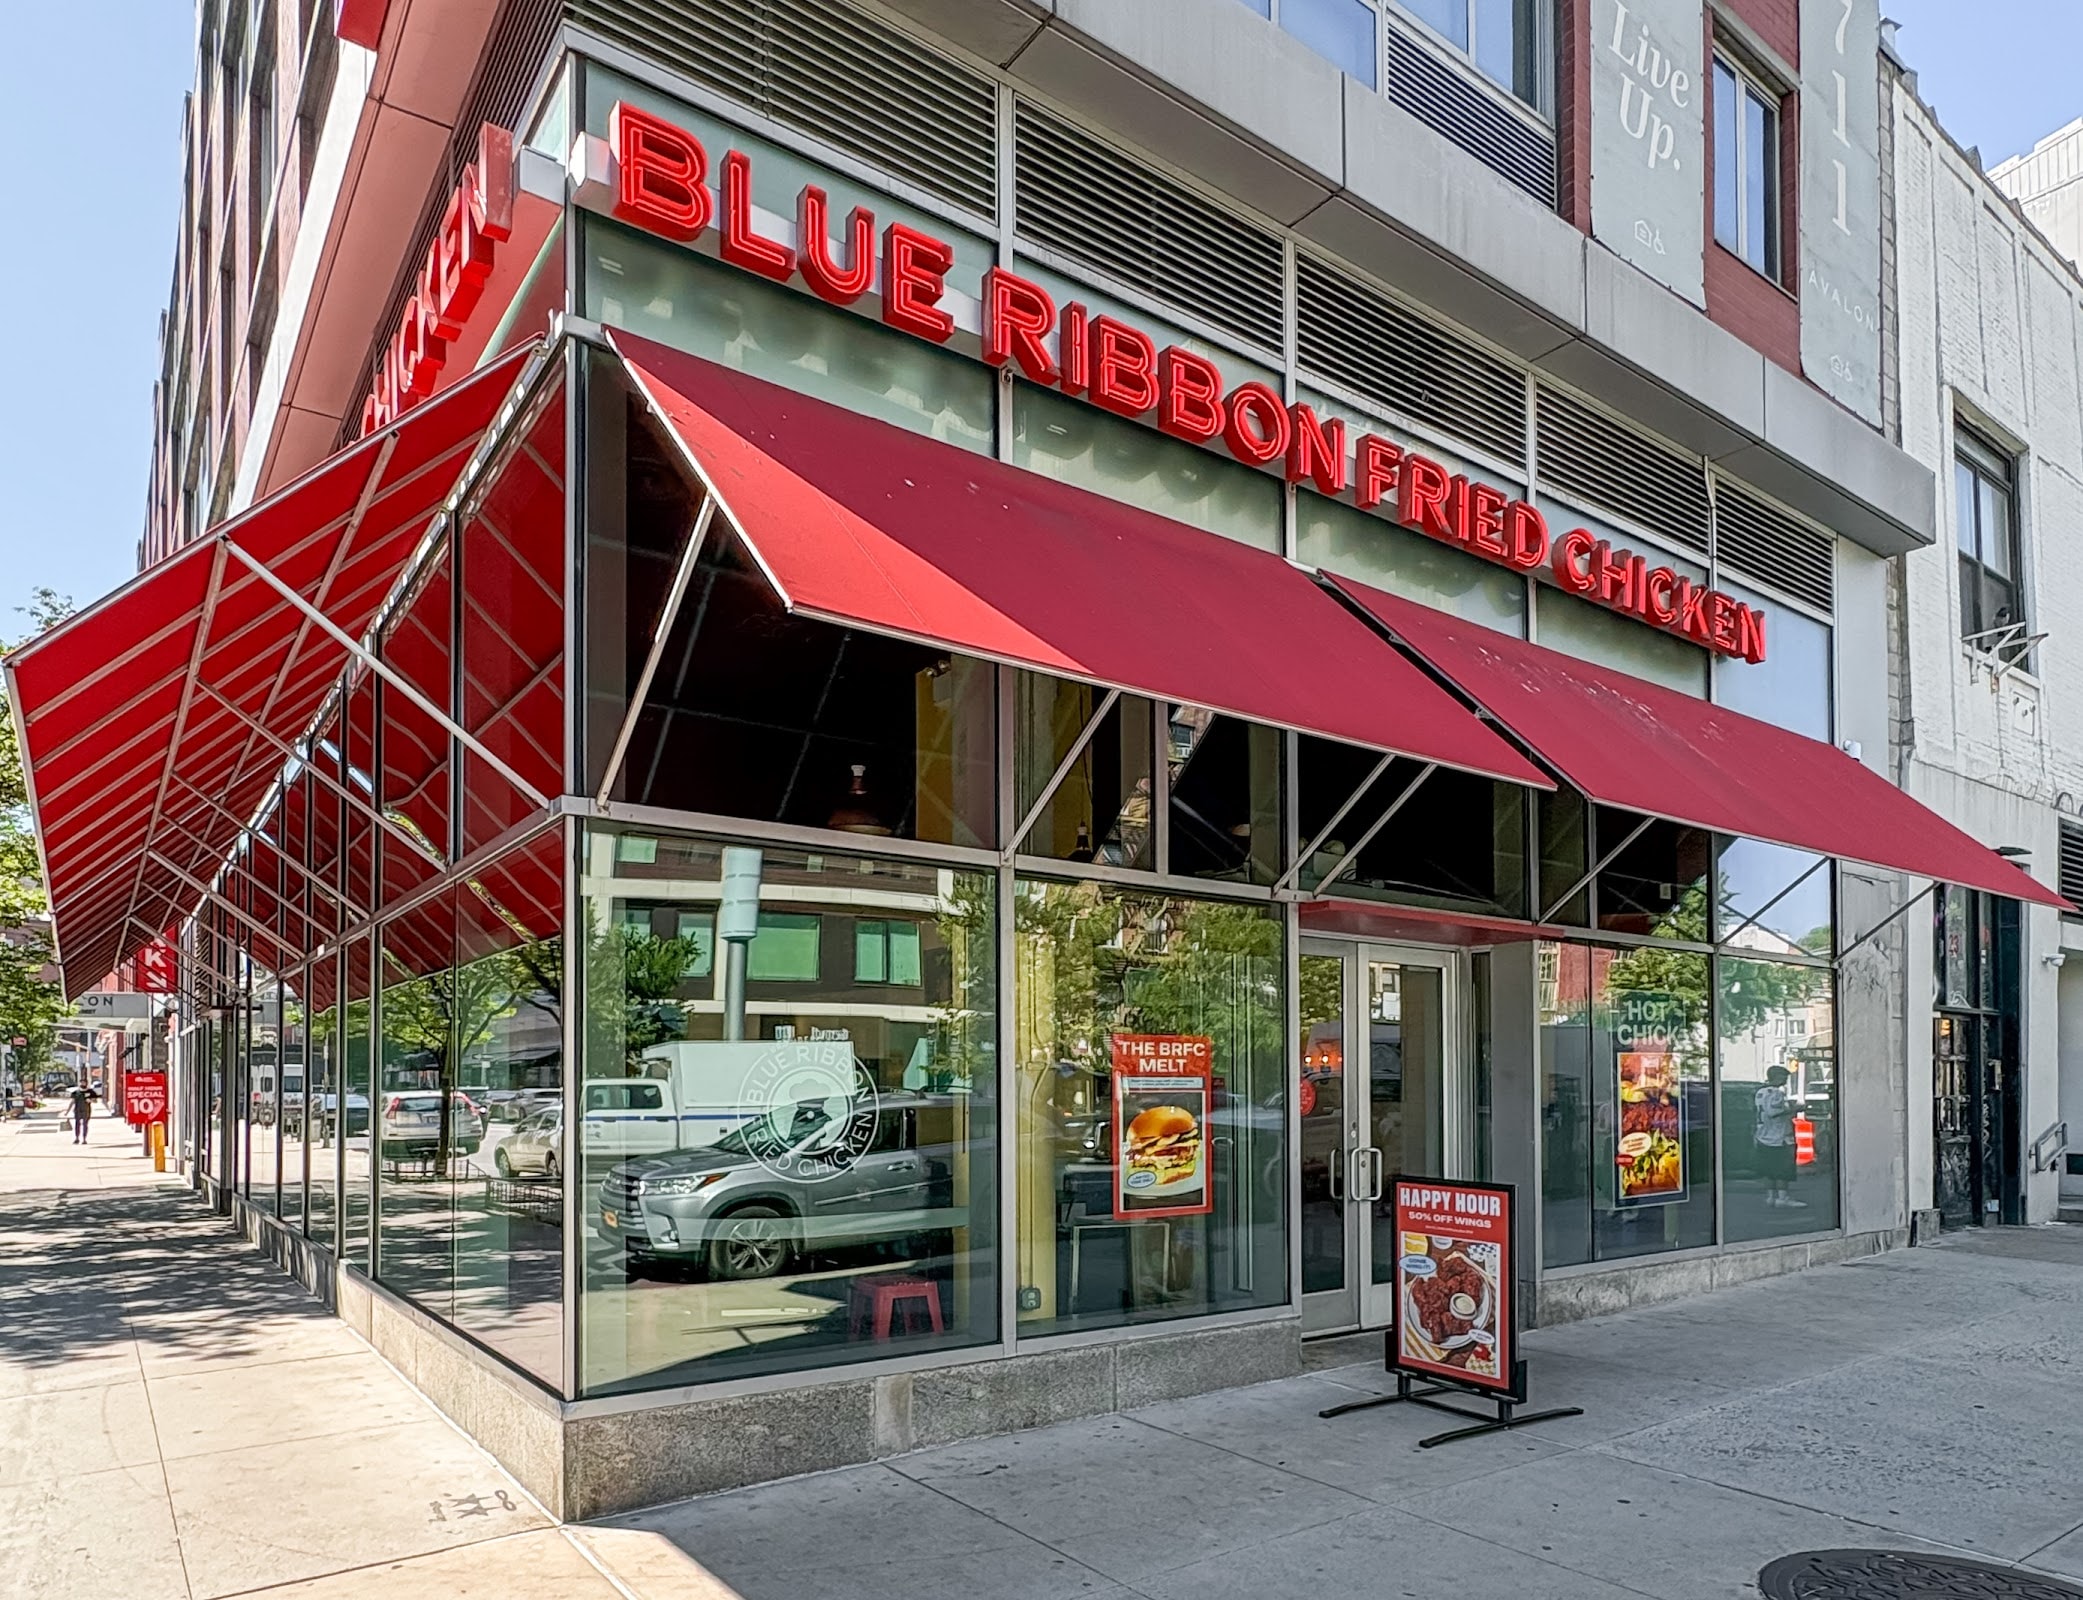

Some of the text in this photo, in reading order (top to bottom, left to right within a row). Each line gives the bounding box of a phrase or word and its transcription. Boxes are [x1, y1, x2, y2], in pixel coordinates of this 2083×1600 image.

[1608, 0, 1690, 108] Live
[1619, 72, 1681, 171] Up.
[1808, 270, 1875, 332] AVALON
[608, 100, 1767, 664] BLUE RIBBON FRIED CHICKEN
[1627, 1000, 1668, 1021] HOT
[746, 1046, 872, 1105] BLUE RIBBON
[1120, 1041, 1206, 1057] THE BRFC
[1139, 1058, 1187, 1073] MELT
[749, 1110, 873, 1176] FRIED CHICKEN
[1400, 1187, 1501, 1216] HAPPY HOUR
[1408, 1211, 1432, 1222] 50%
[1433, 1214, 1454, 1224] OFF
[1454, 1217, 1493, 1229] WINGS
